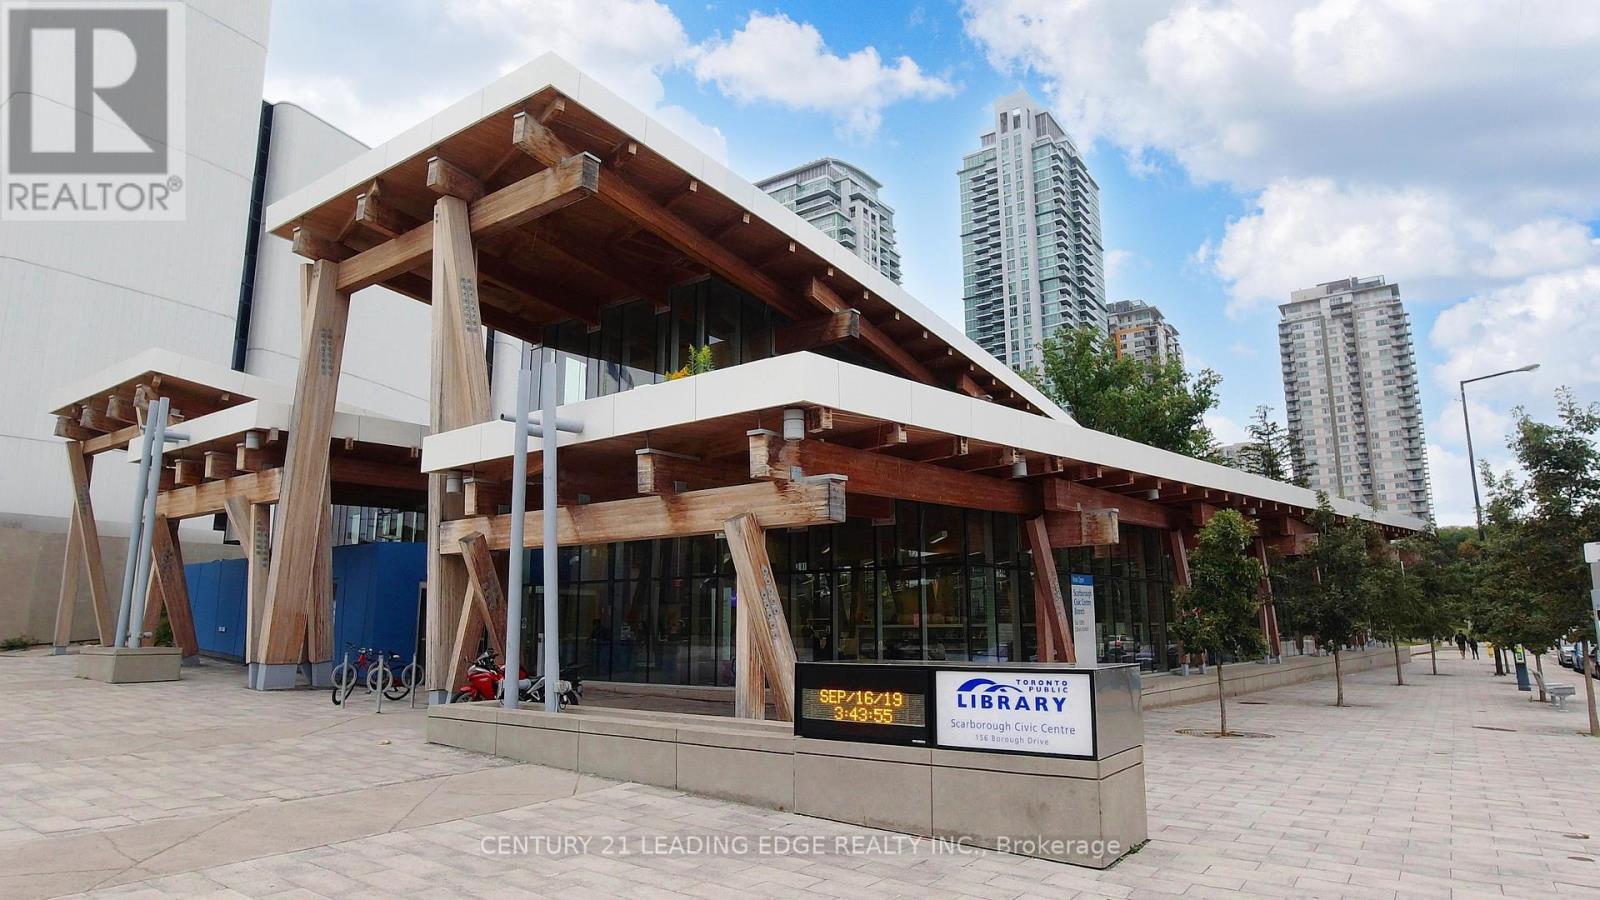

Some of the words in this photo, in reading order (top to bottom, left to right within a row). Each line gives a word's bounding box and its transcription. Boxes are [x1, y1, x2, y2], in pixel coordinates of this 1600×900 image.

[1016, 679, 1068, 687] TORONTO
[820, 689, 903, 707] SEP/16/19
[957, 693, 1067, 712] LIBRARY
[834, 706, 893, 724] 3:43:55
[950, 718, 1011, 733] Scarborough
[1014, 721, 1038, 733] Civic
[1041, 723, 1076, 735] Centre
[991, 735, 1024, 745] Borough
[1028, 737, 1049, 746] Drive
